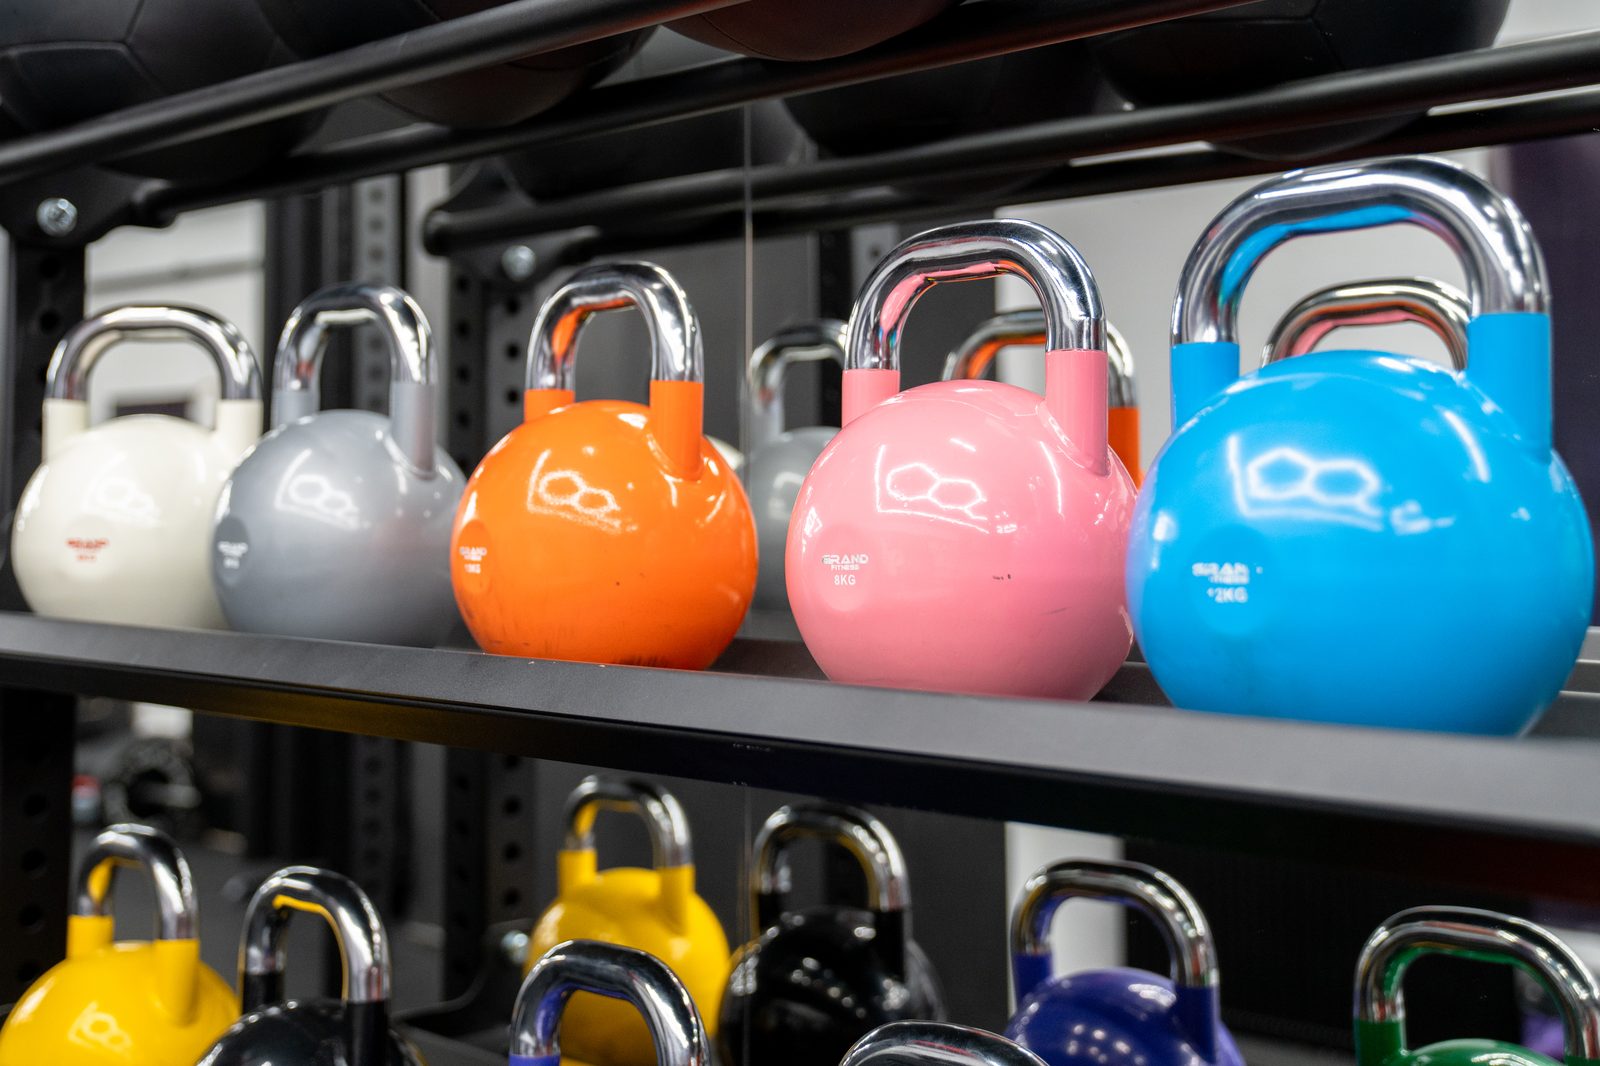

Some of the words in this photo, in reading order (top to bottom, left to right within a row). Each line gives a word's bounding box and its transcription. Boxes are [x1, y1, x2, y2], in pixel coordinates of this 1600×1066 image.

[822, 554, 869, 565] GRAND
[1192, 562, 1250, 577] GRAN
[834, 574, 856, 586] 8KG
